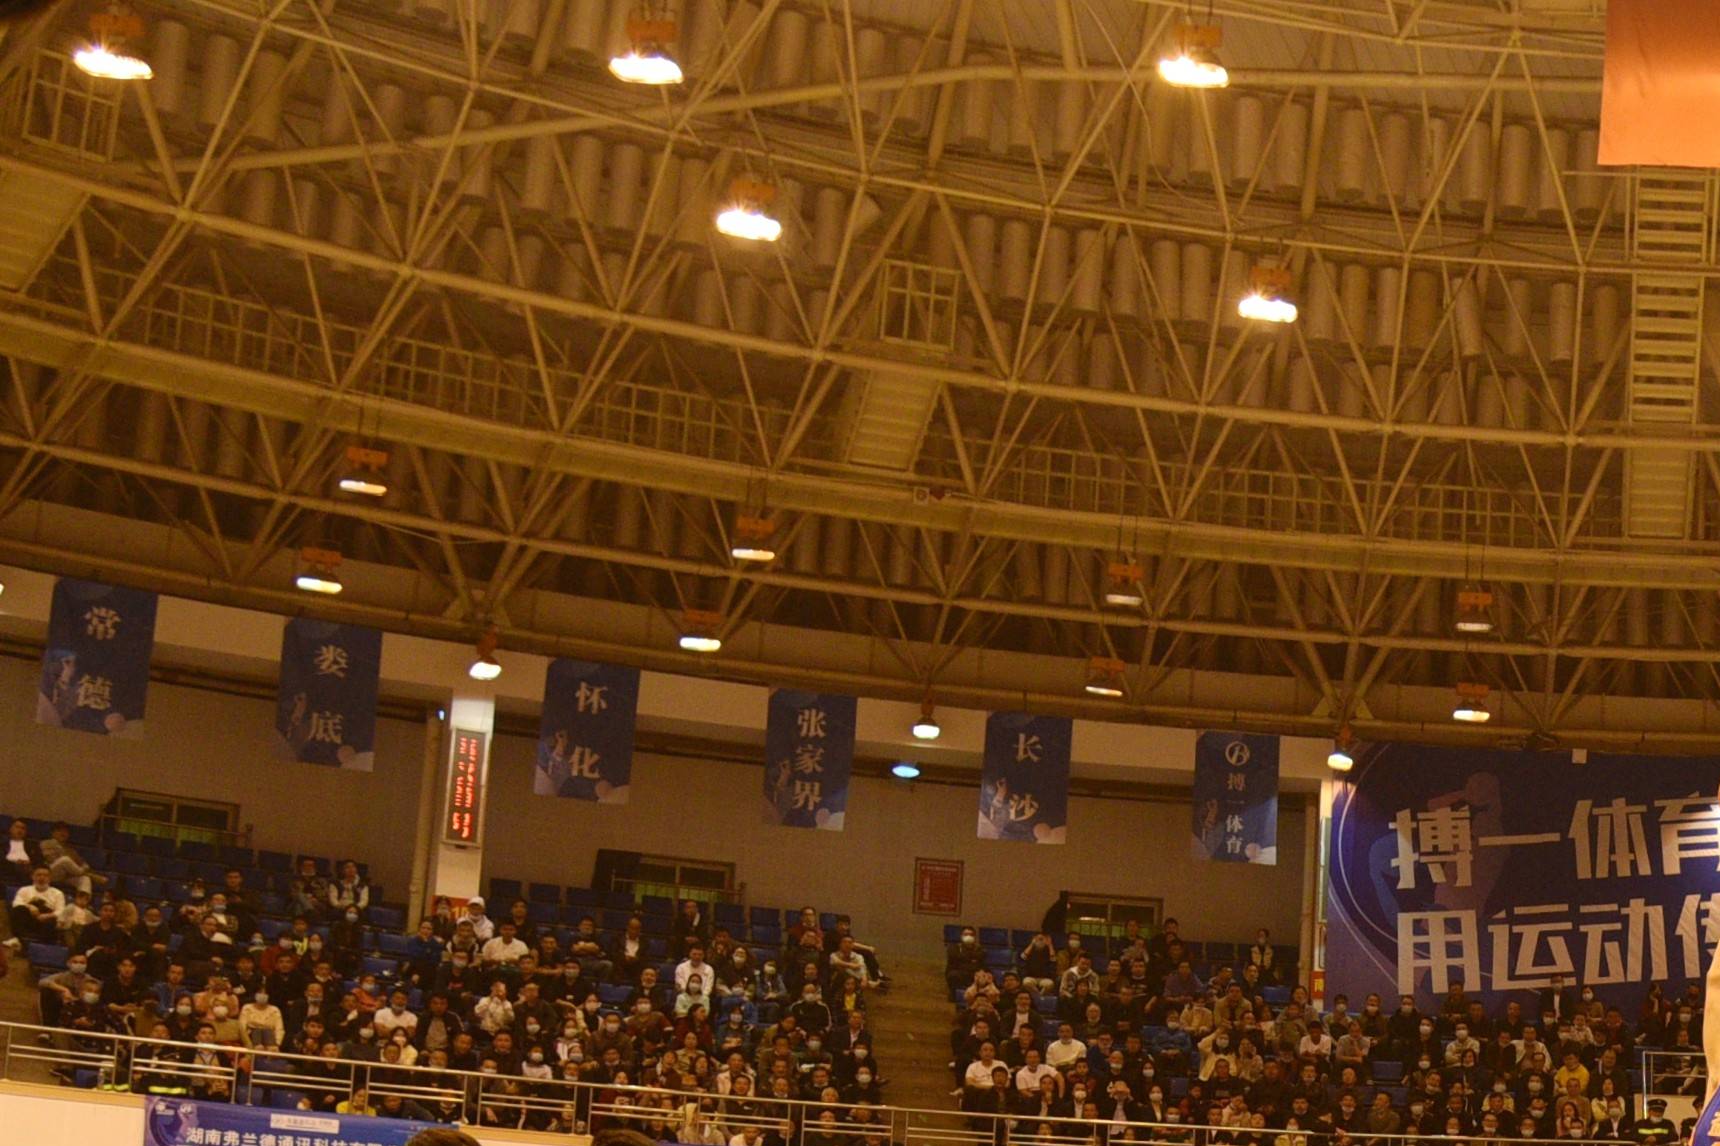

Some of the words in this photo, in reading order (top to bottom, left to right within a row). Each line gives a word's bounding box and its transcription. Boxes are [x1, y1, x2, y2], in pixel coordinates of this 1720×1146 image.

[77, 606, 122, 710] 常德
[308, 645, 349, 744] 娄底
[568, 681, 608, 779] 怀化
[792, 708, 827, 811] 张家界
[1009, 733, 1043, 822] 长沙
